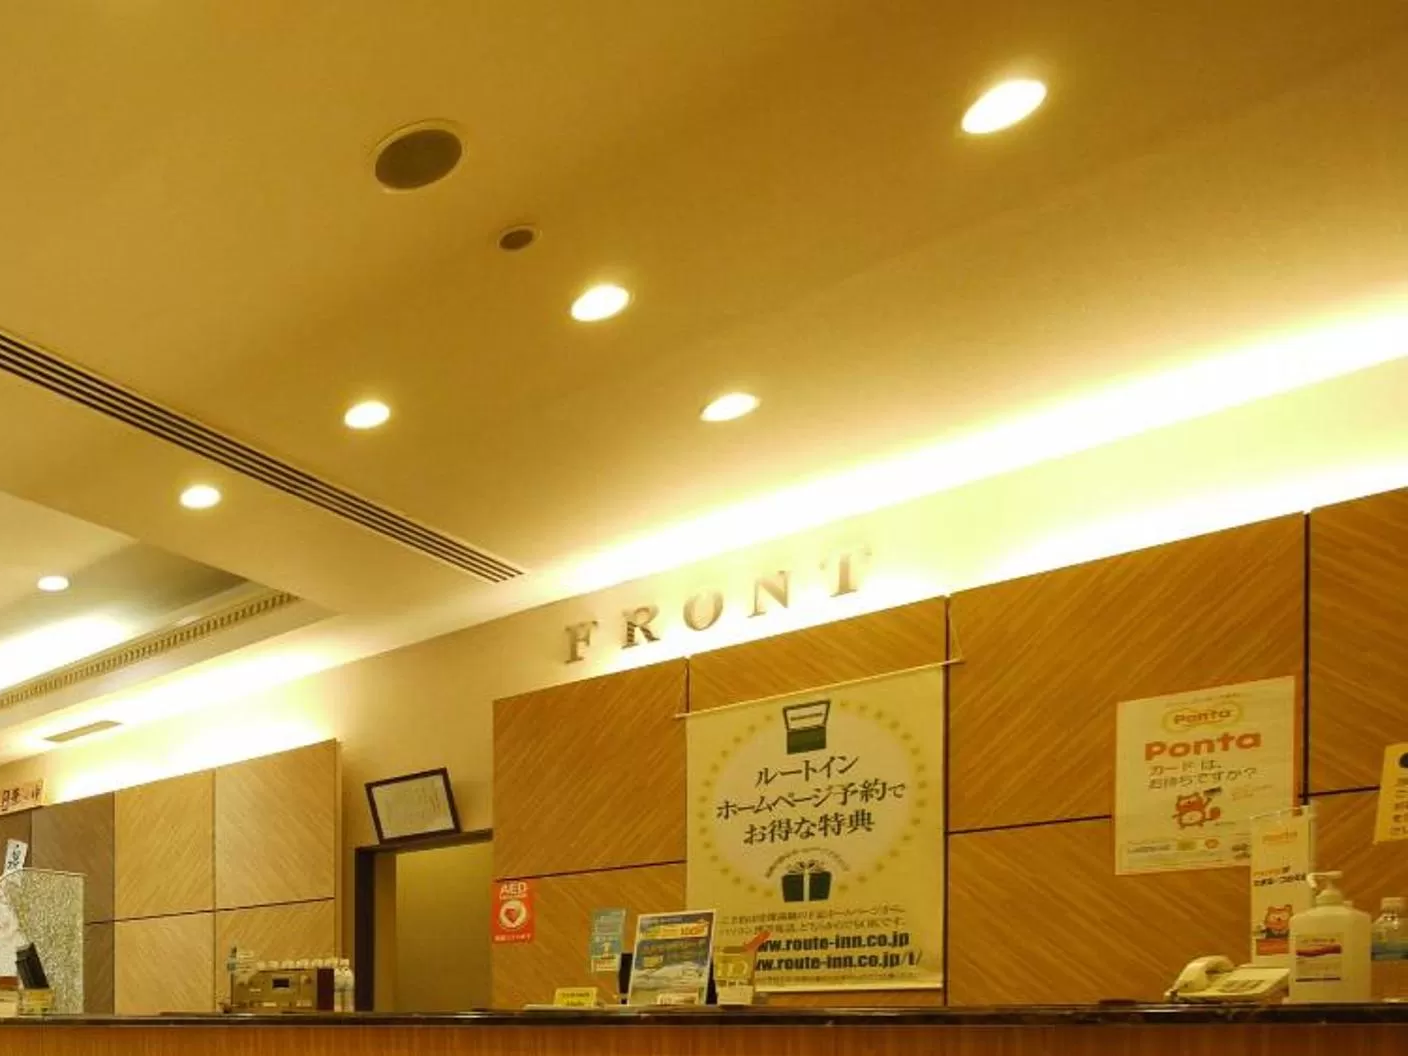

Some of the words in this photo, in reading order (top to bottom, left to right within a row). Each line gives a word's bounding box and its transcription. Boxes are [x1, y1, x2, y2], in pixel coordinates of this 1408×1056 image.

[564, 546, 873, 665] FRONT
[1173, 708, 1233, 726] Ponta
[1144, 731, 1262, 761] Ponta
[755, 755, 859, 788] ルートイン
[716, 778, 906, 820] ホームページ予約で
[743, 808, 875, 846] お得な特典
[500, 881, 528, 895] AED
